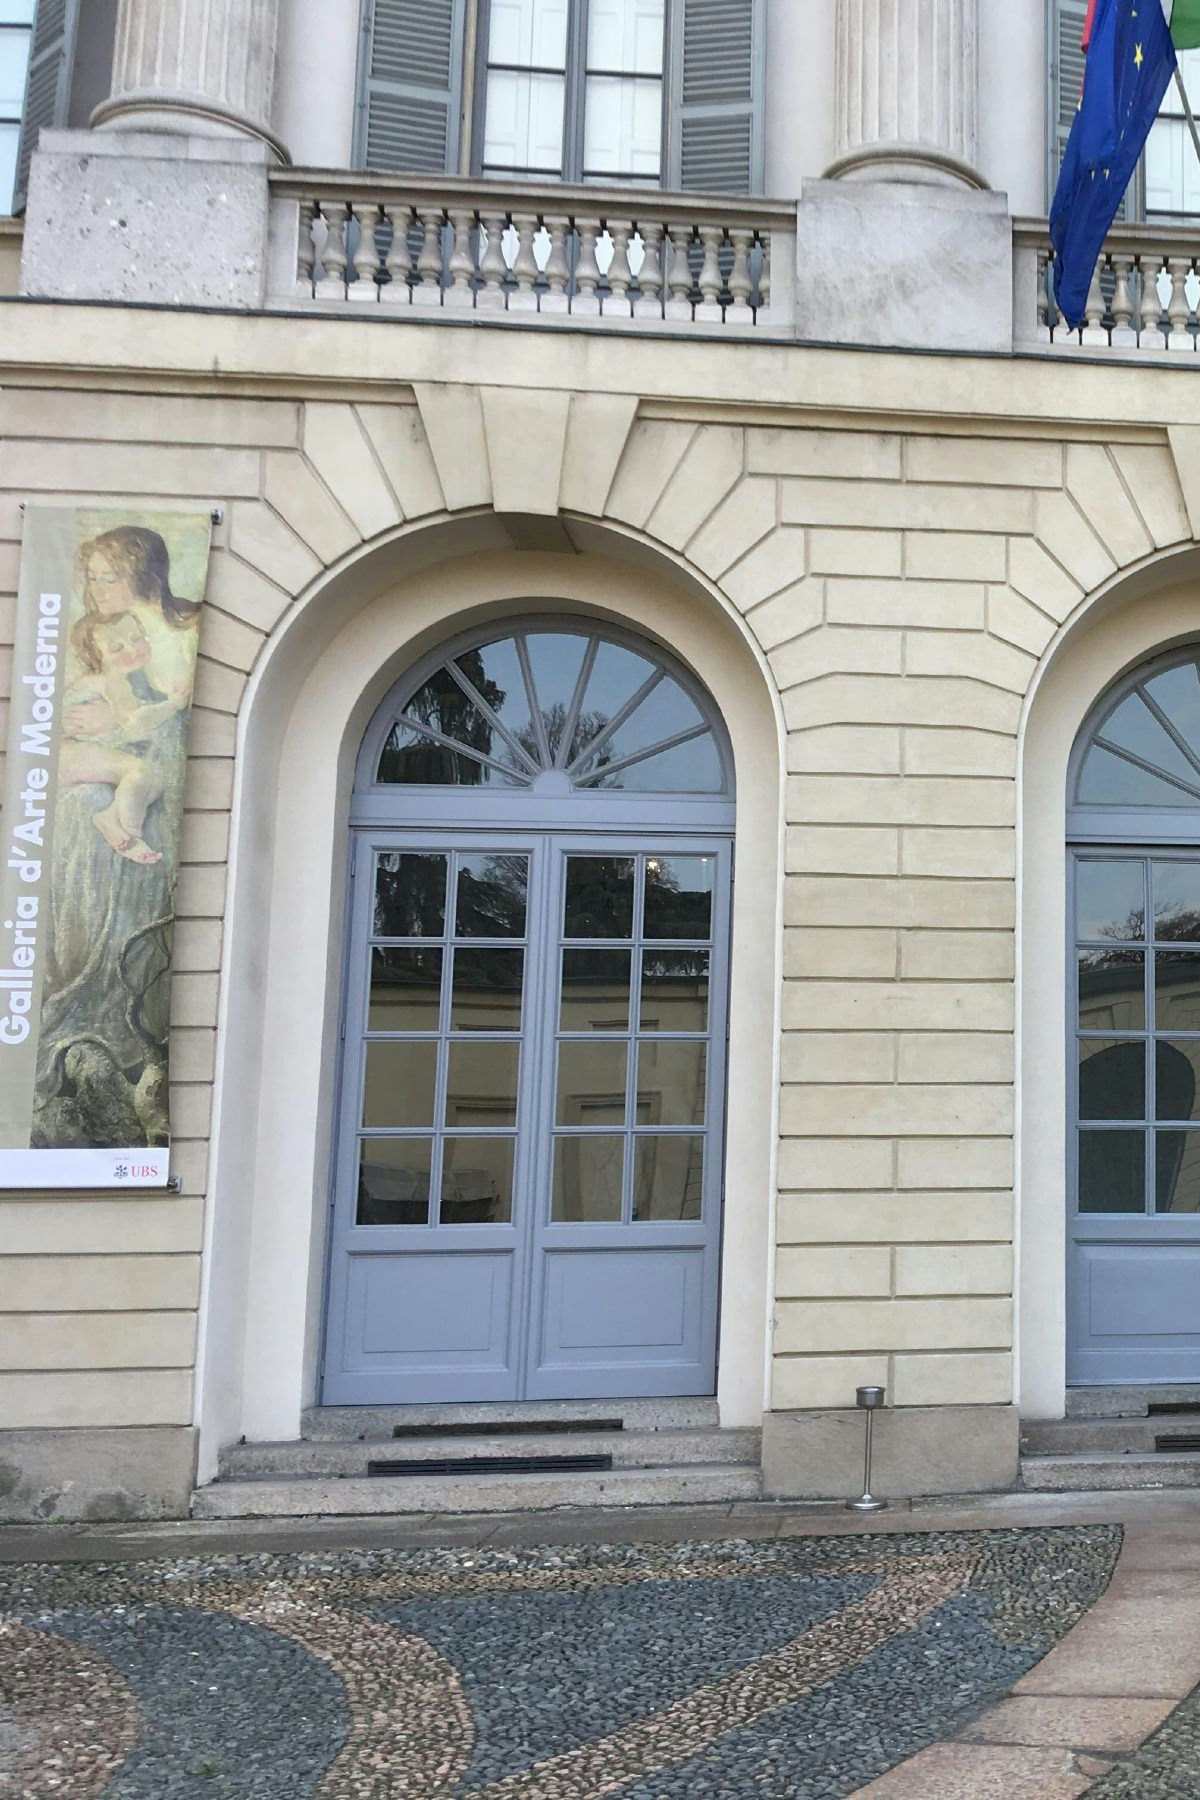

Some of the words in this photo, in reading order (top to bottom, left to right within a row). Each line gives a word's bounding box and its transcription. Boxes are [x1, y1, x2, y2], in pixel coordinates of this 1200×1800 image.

[20, 593, 62, 756] Moderna
[8, 768, 49, 882] d'Arte
[0, 897, 39, 1044] Galleria
[130, 1165, 158, 1178] UBS
